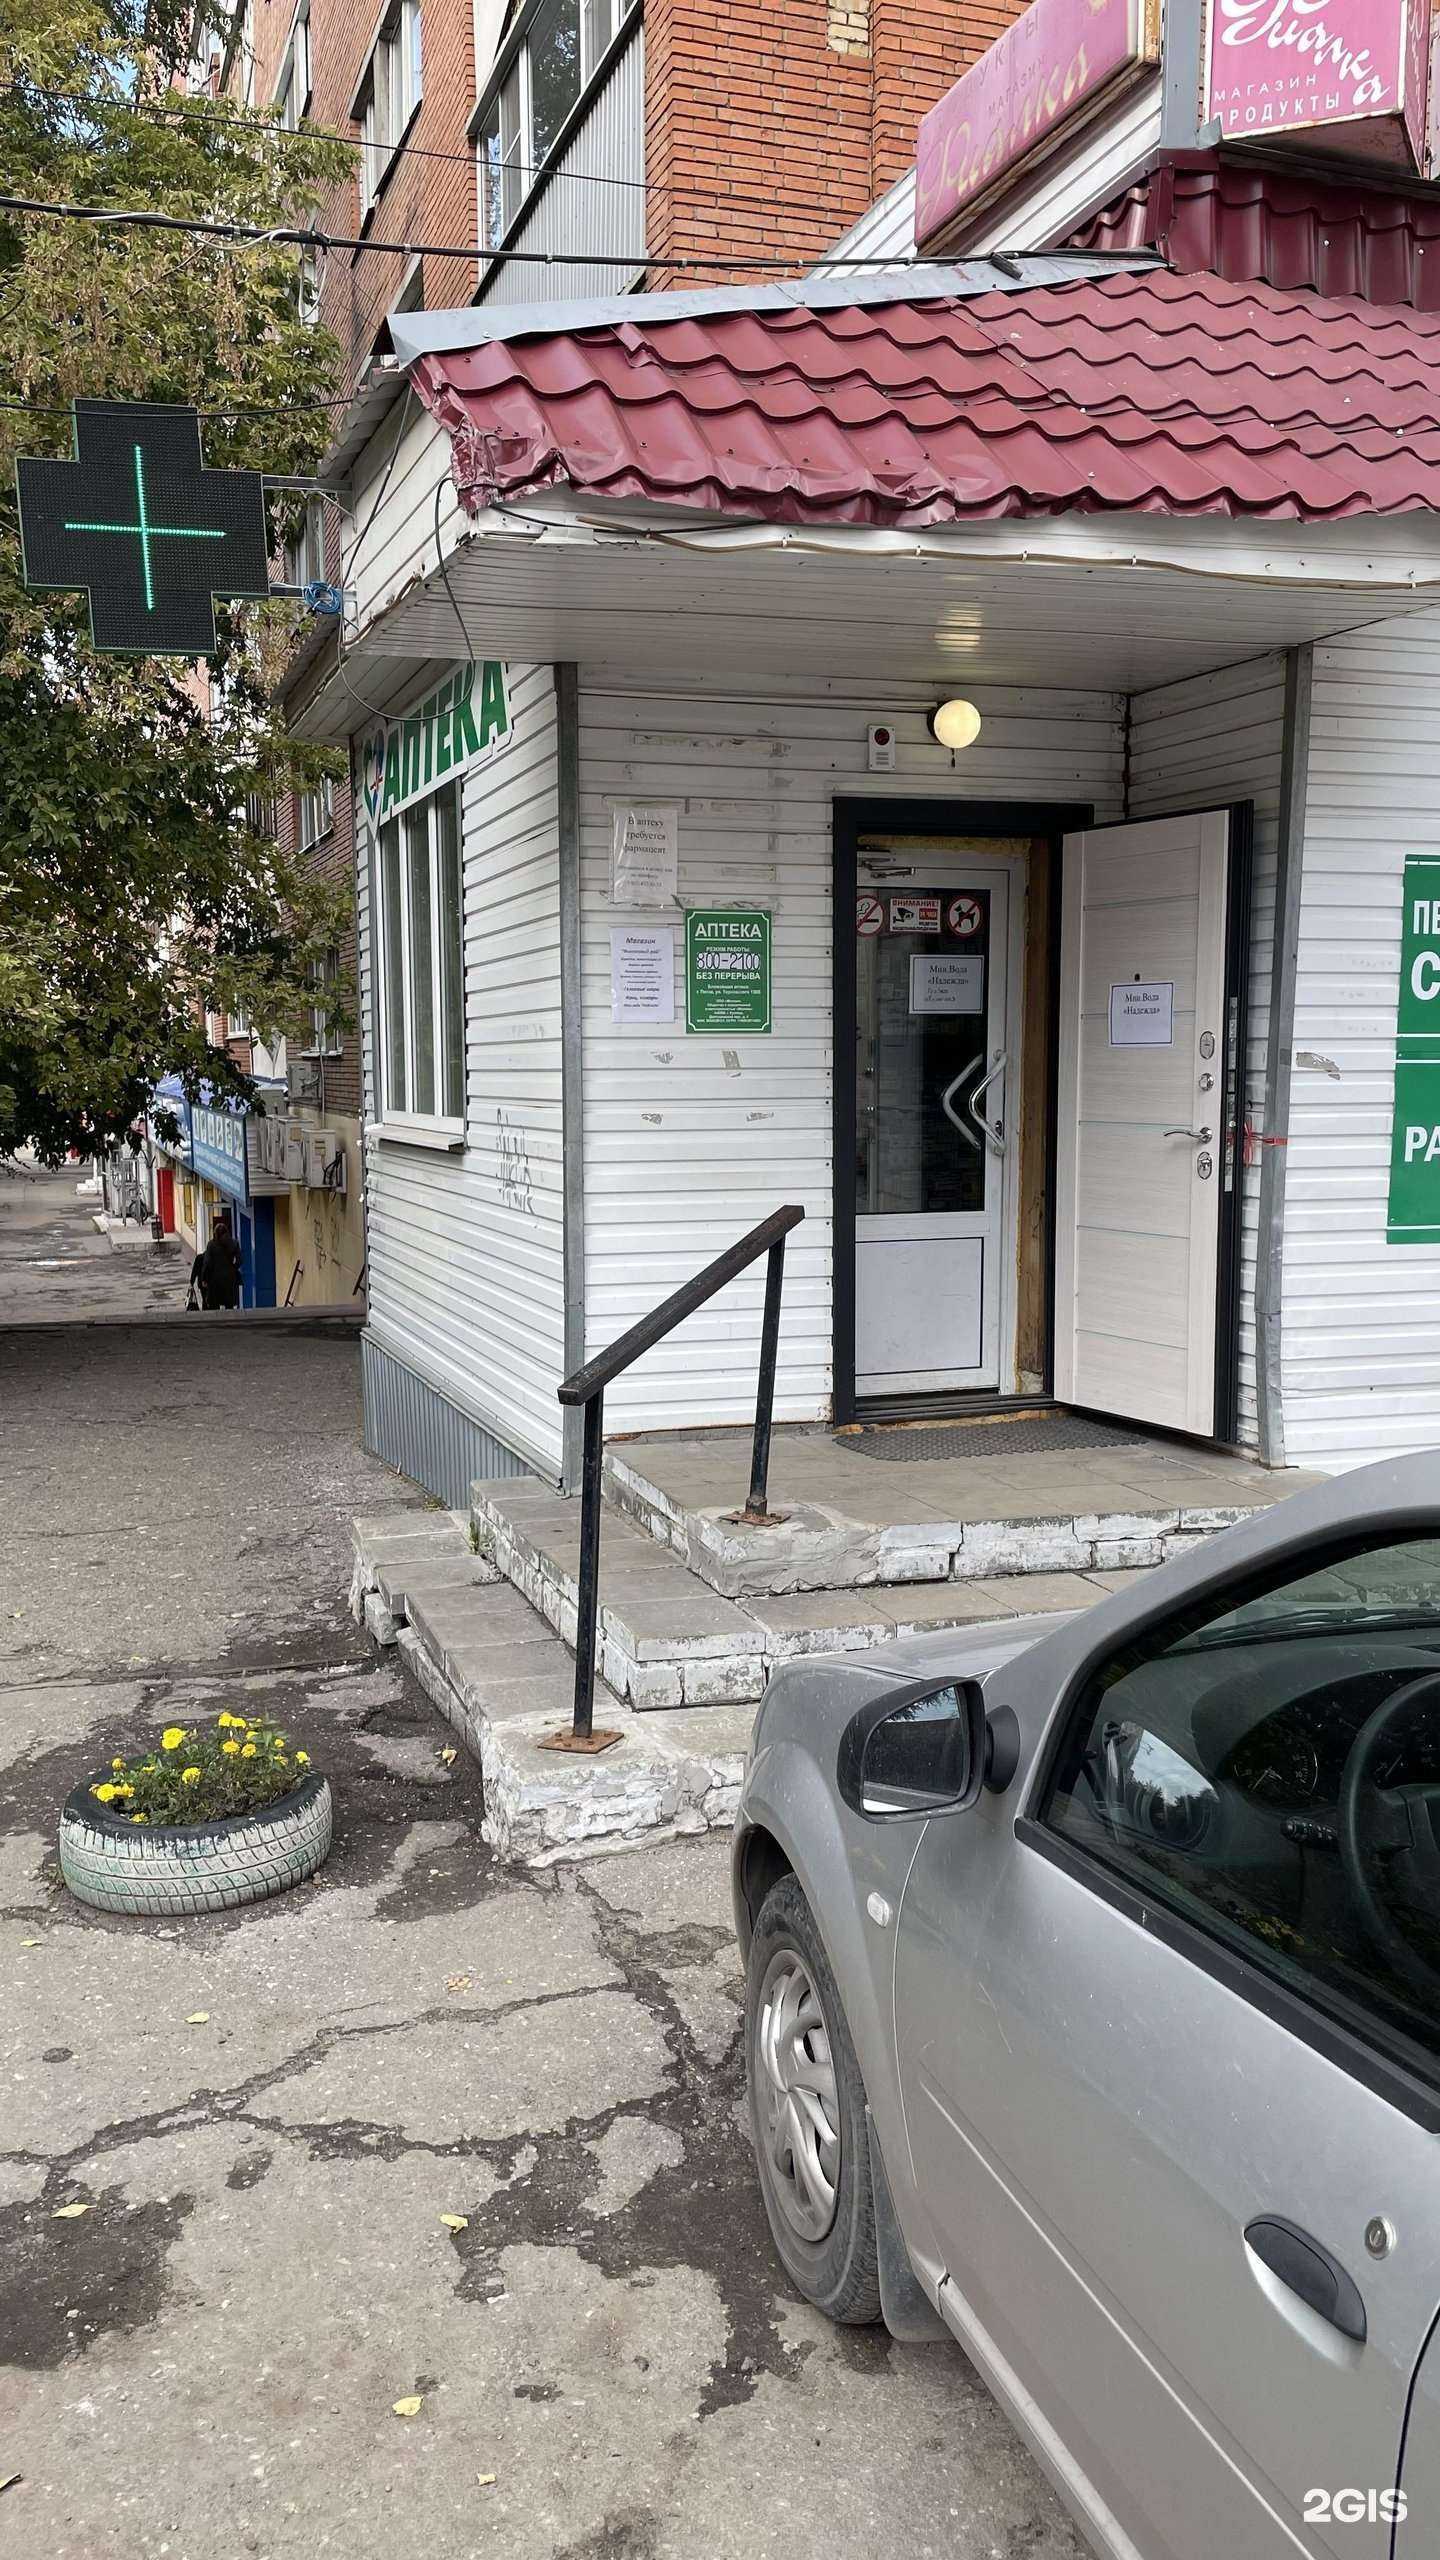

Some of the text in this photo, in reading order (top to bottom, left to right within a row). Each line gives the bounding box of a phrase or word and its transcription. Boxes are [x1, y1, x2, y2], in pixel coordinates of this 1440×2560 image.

[1213, 74, 1317, 102] МАГАЗИН
[382, 661, 508, 815] АПТЕКА
[694, 923, 762, 938] АПТЕКА
[696, 971, 760, 980] БЕЗ ПЕРЕРЫВА
